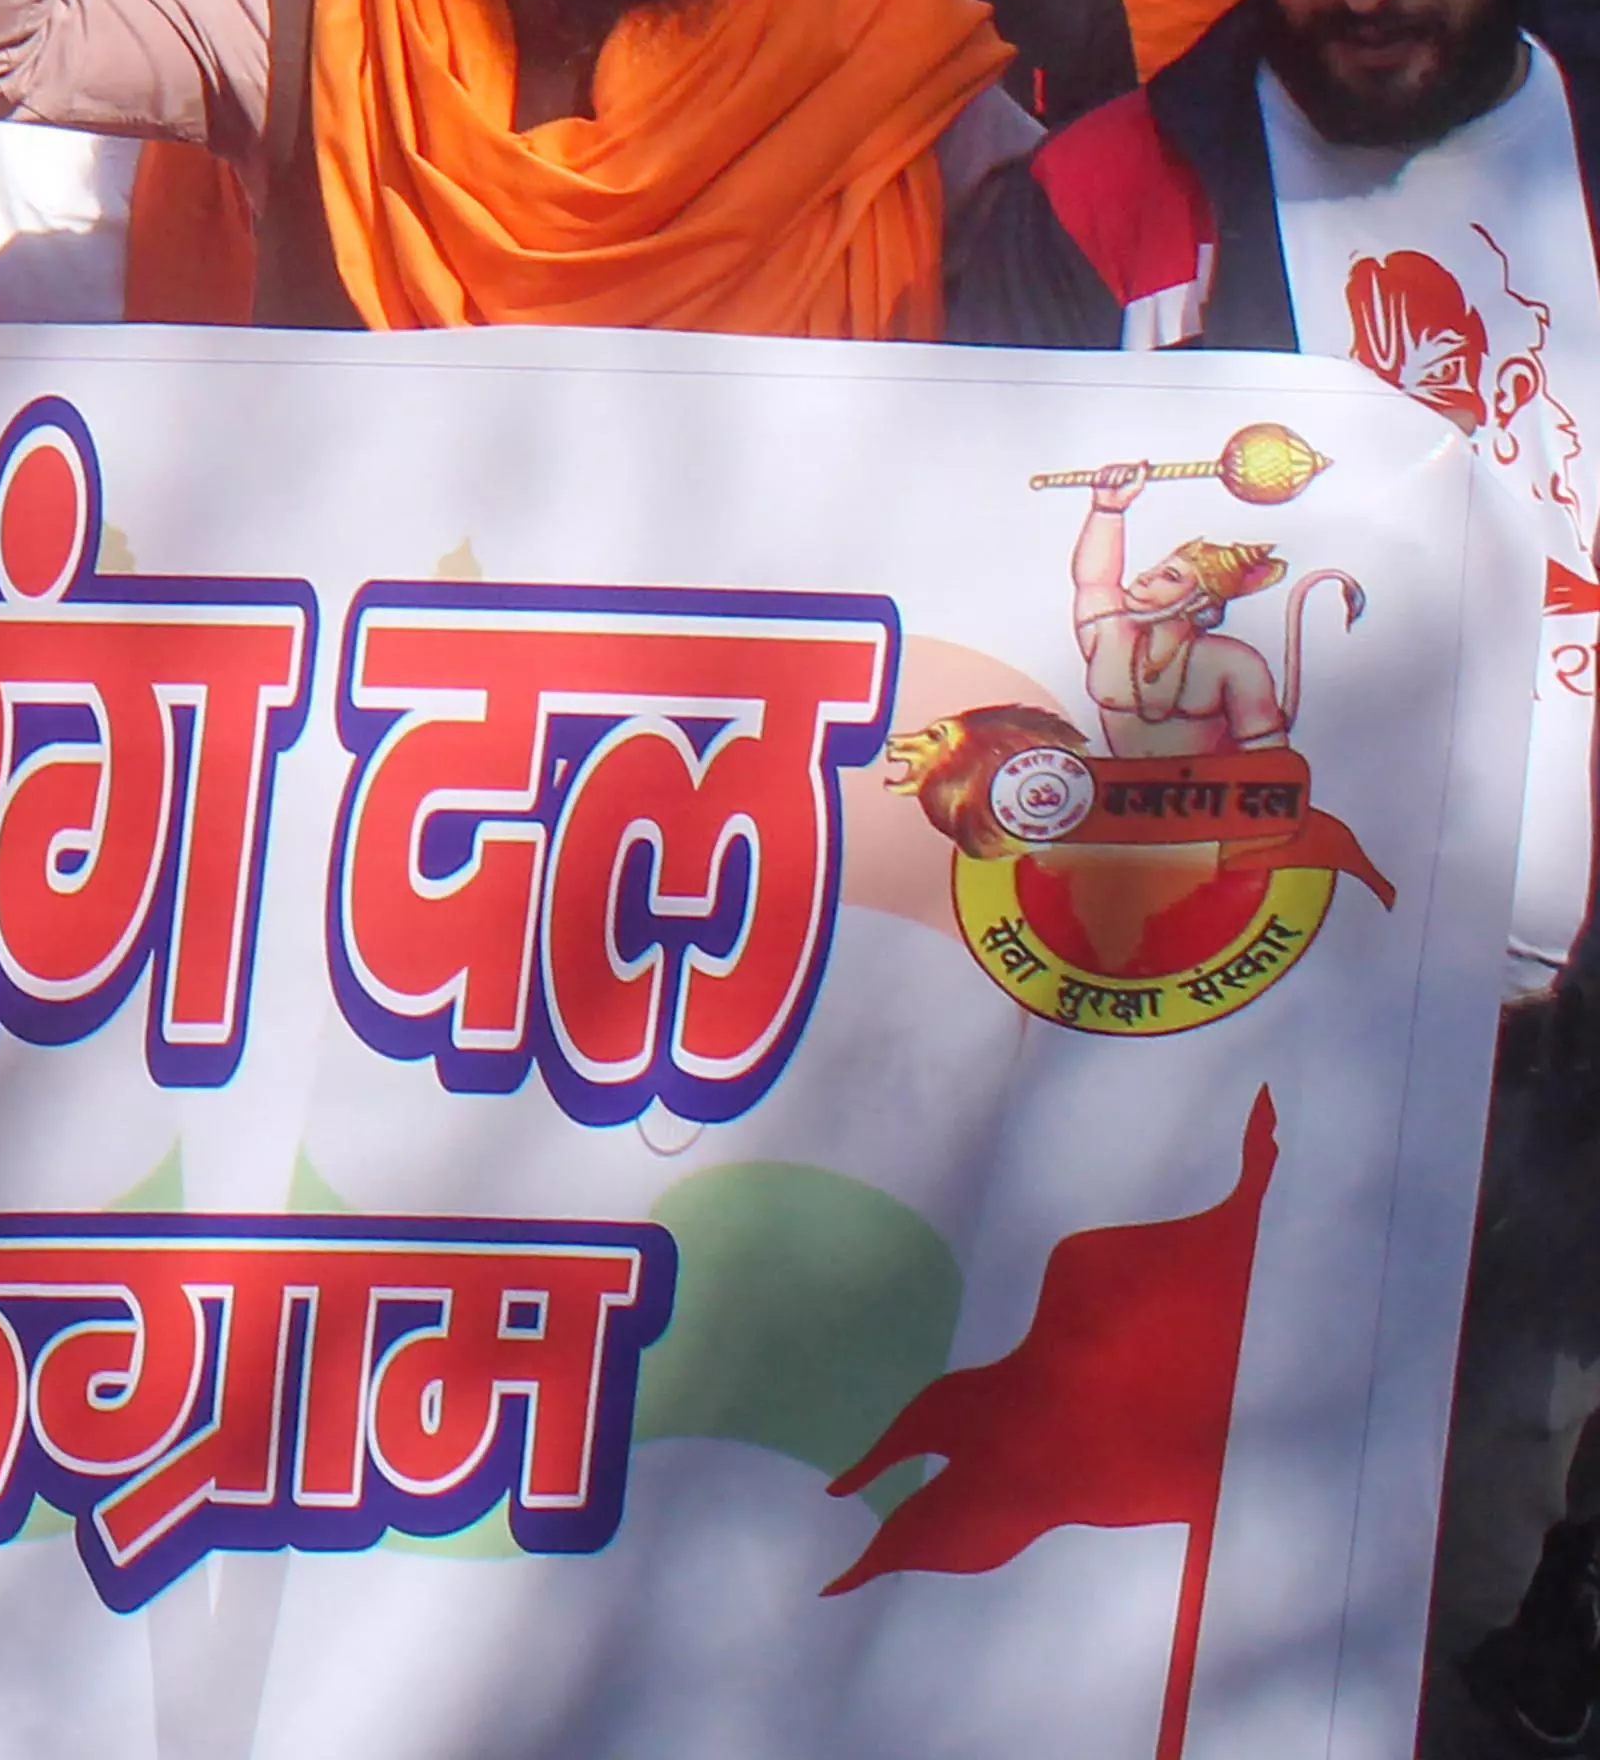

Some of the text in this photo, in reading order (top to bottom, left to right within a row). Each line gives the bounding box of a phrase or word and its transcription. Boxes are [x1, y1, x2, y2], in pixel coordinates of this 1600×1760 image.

[1103, 767, 1303, 819] बजरंग दल
[325, 579, 900, 1130] दल
[1055, 973, 1164, 1027] सुरक्षा
[1177, 912, 1304, 1005] संस्कार
